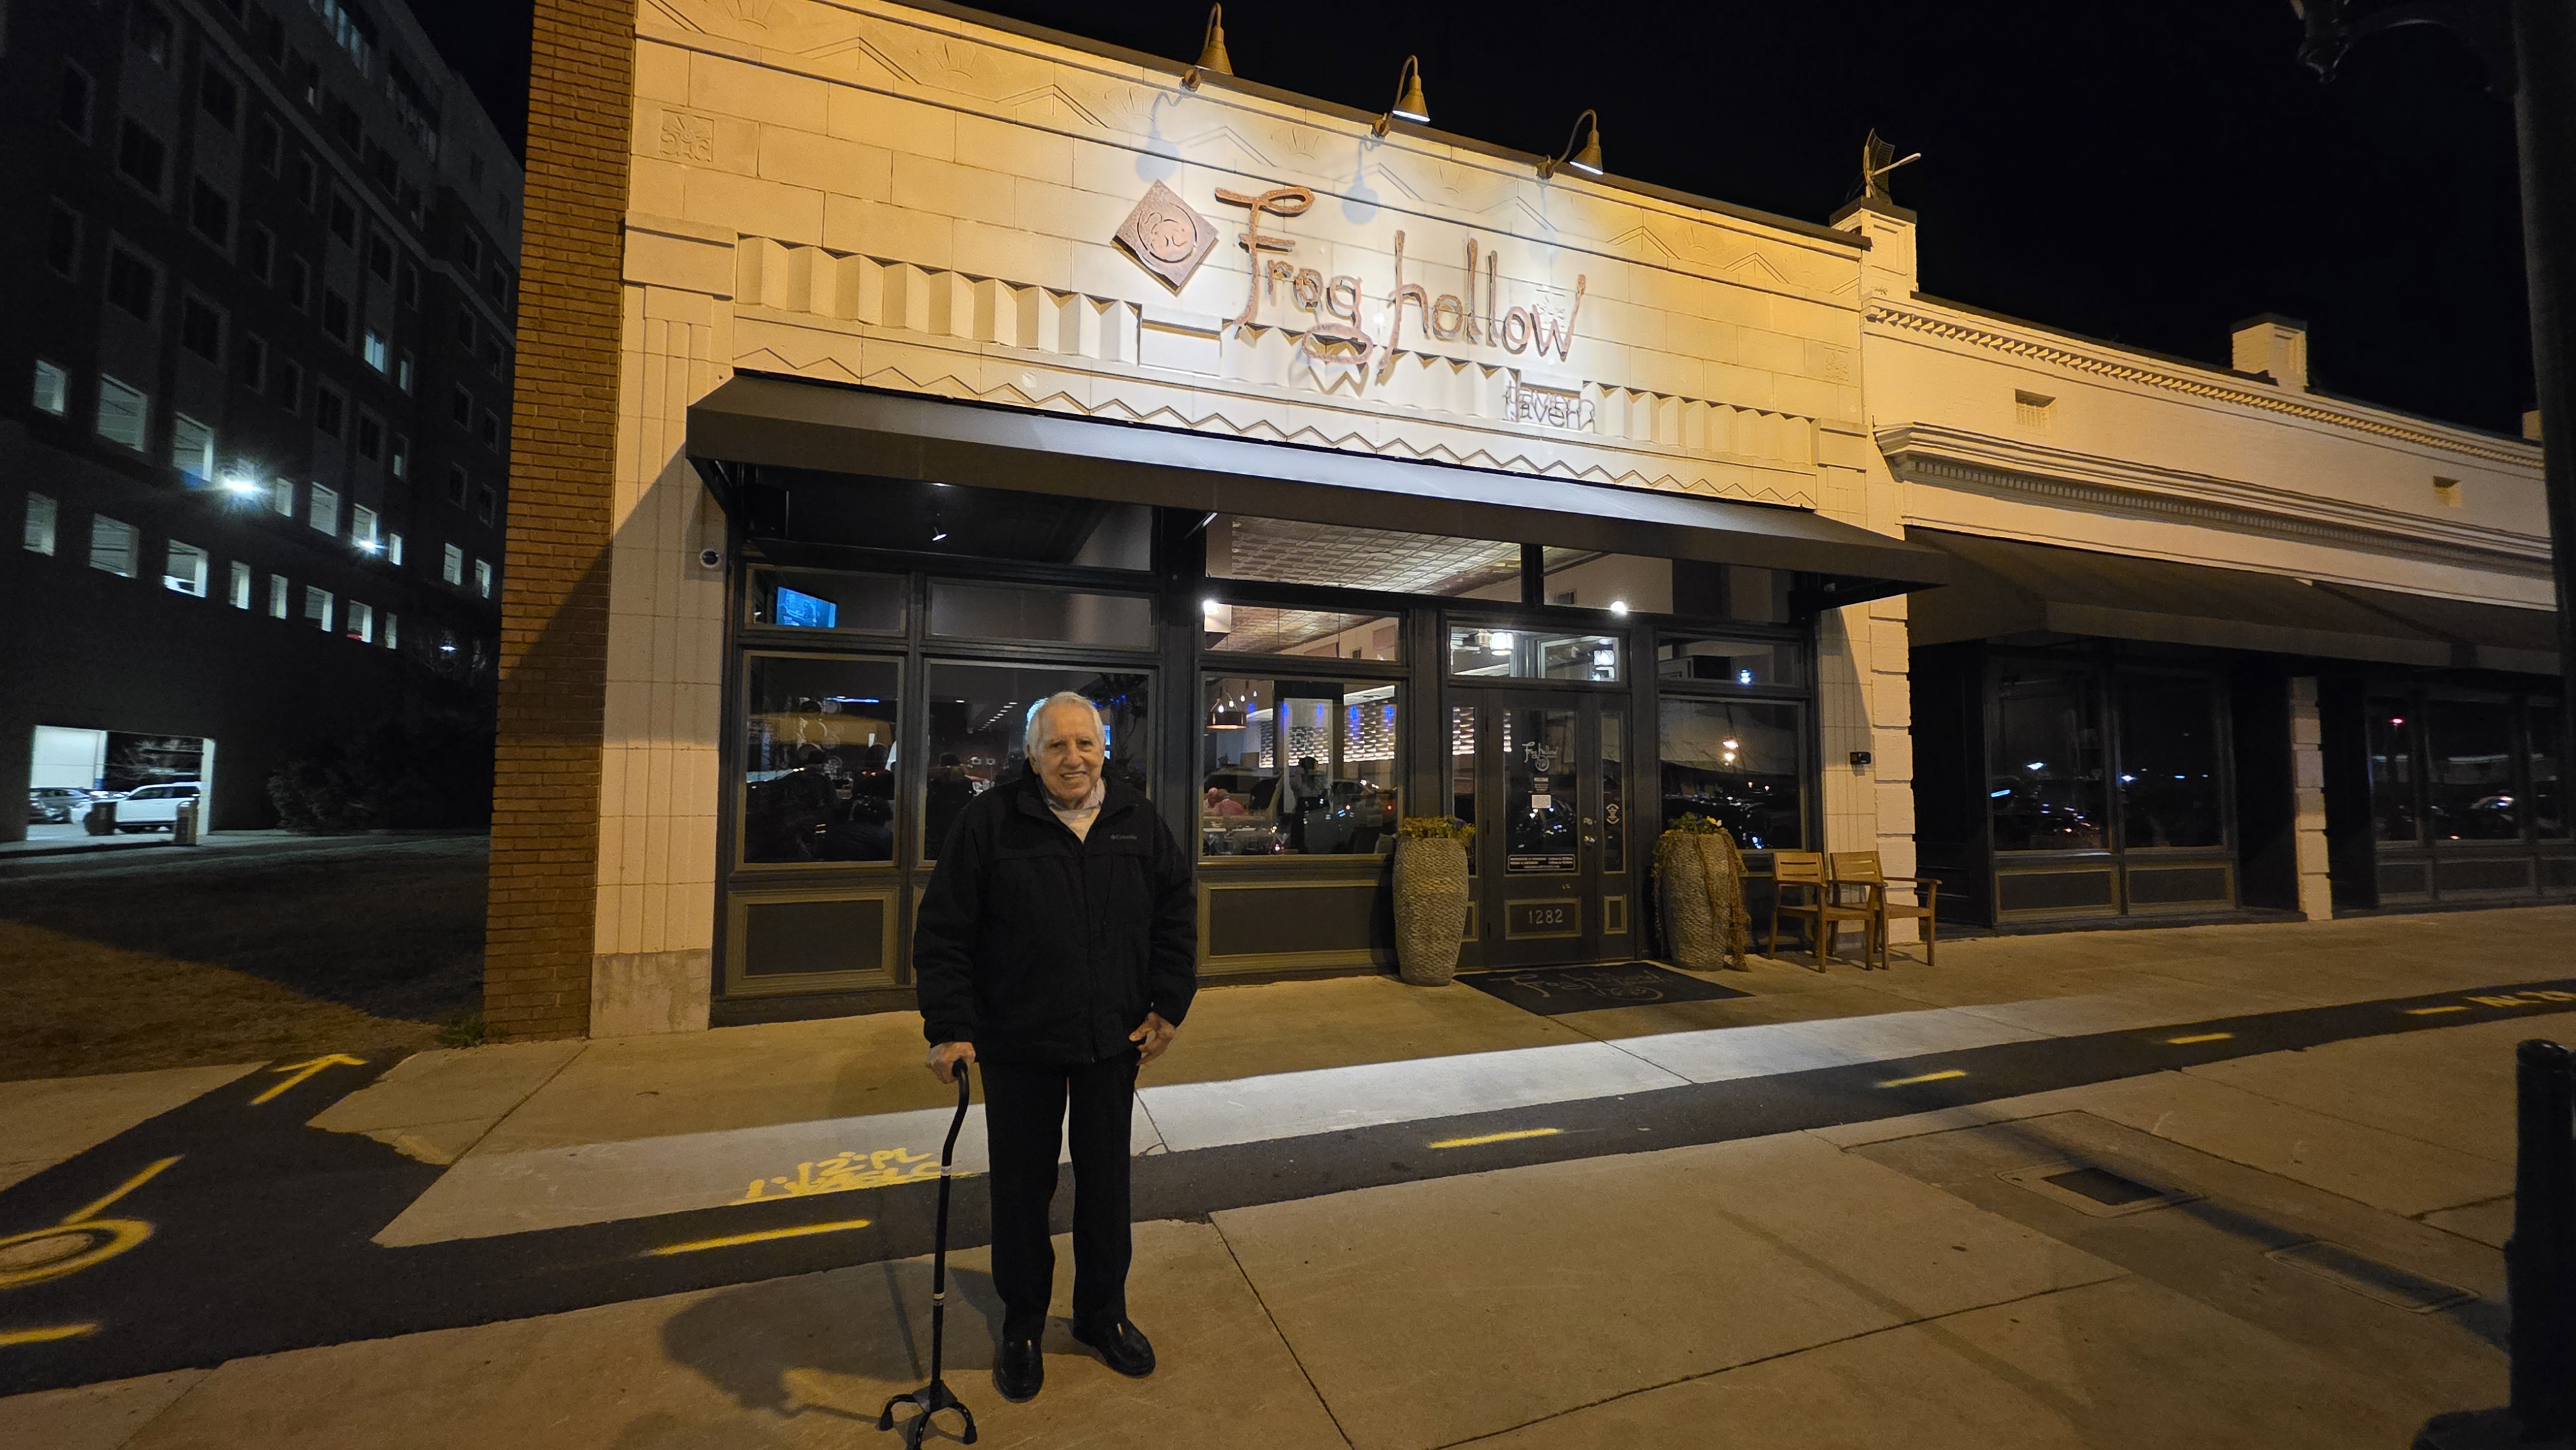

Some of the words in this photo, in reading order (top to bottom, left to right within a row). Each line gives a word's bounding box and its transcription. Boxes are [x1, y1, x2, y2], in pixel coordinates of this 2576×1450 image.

[1215, 187, 1373, 365] Frog
[1378, 230, 1586, 372] hollow
[1528, 909, 1563, 924] 1282
